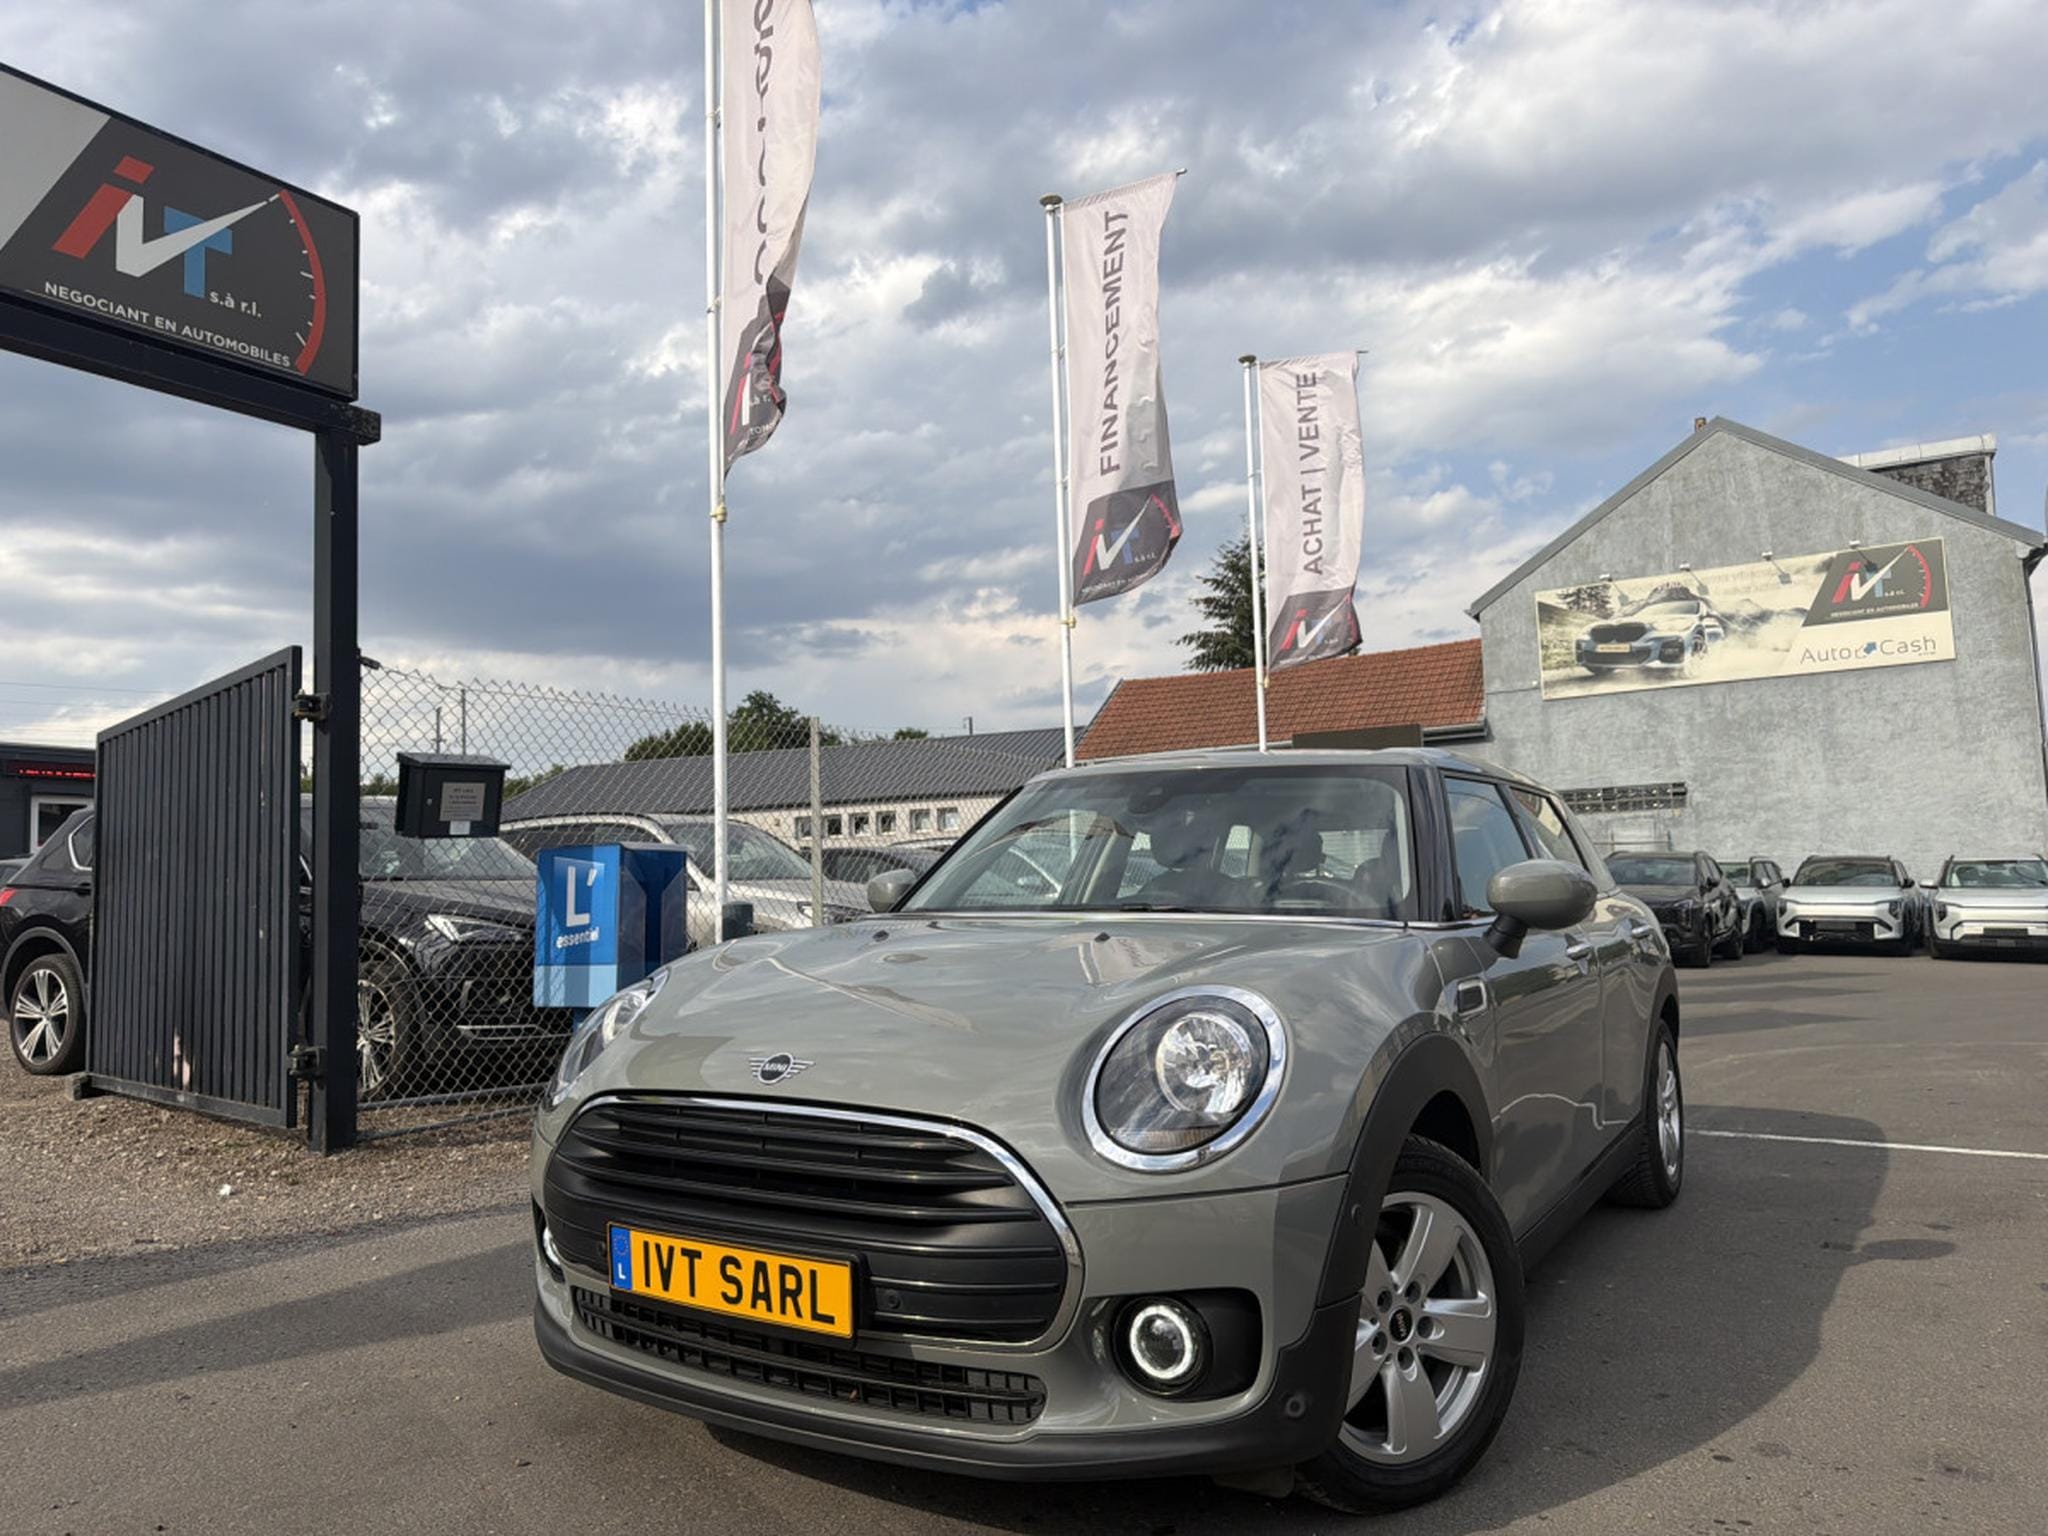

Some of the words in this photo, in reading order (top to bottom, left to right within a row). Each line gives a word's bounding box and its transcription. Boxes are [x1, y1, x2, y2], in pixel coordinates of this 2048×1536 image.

[45, 281, 150, 324] NEGOCIANT
[154, 316, 177, 332] EN
[181, 325, 291, 368] AUTOMOBILES
[240, 302, 262, 318] r.l.
[1100, 211, 1128, 476] FINANCEMENT
[1296, 372, 1320, 461] VENTE
[1301, 484, 1324, 576] ACHAT
[1880, 636, 1936, 655] Cash
[617, 1262, 626, 1280] L
[642, 1240, 702, 1298] IVT
[719, 1254, 836, 1325] SARL
